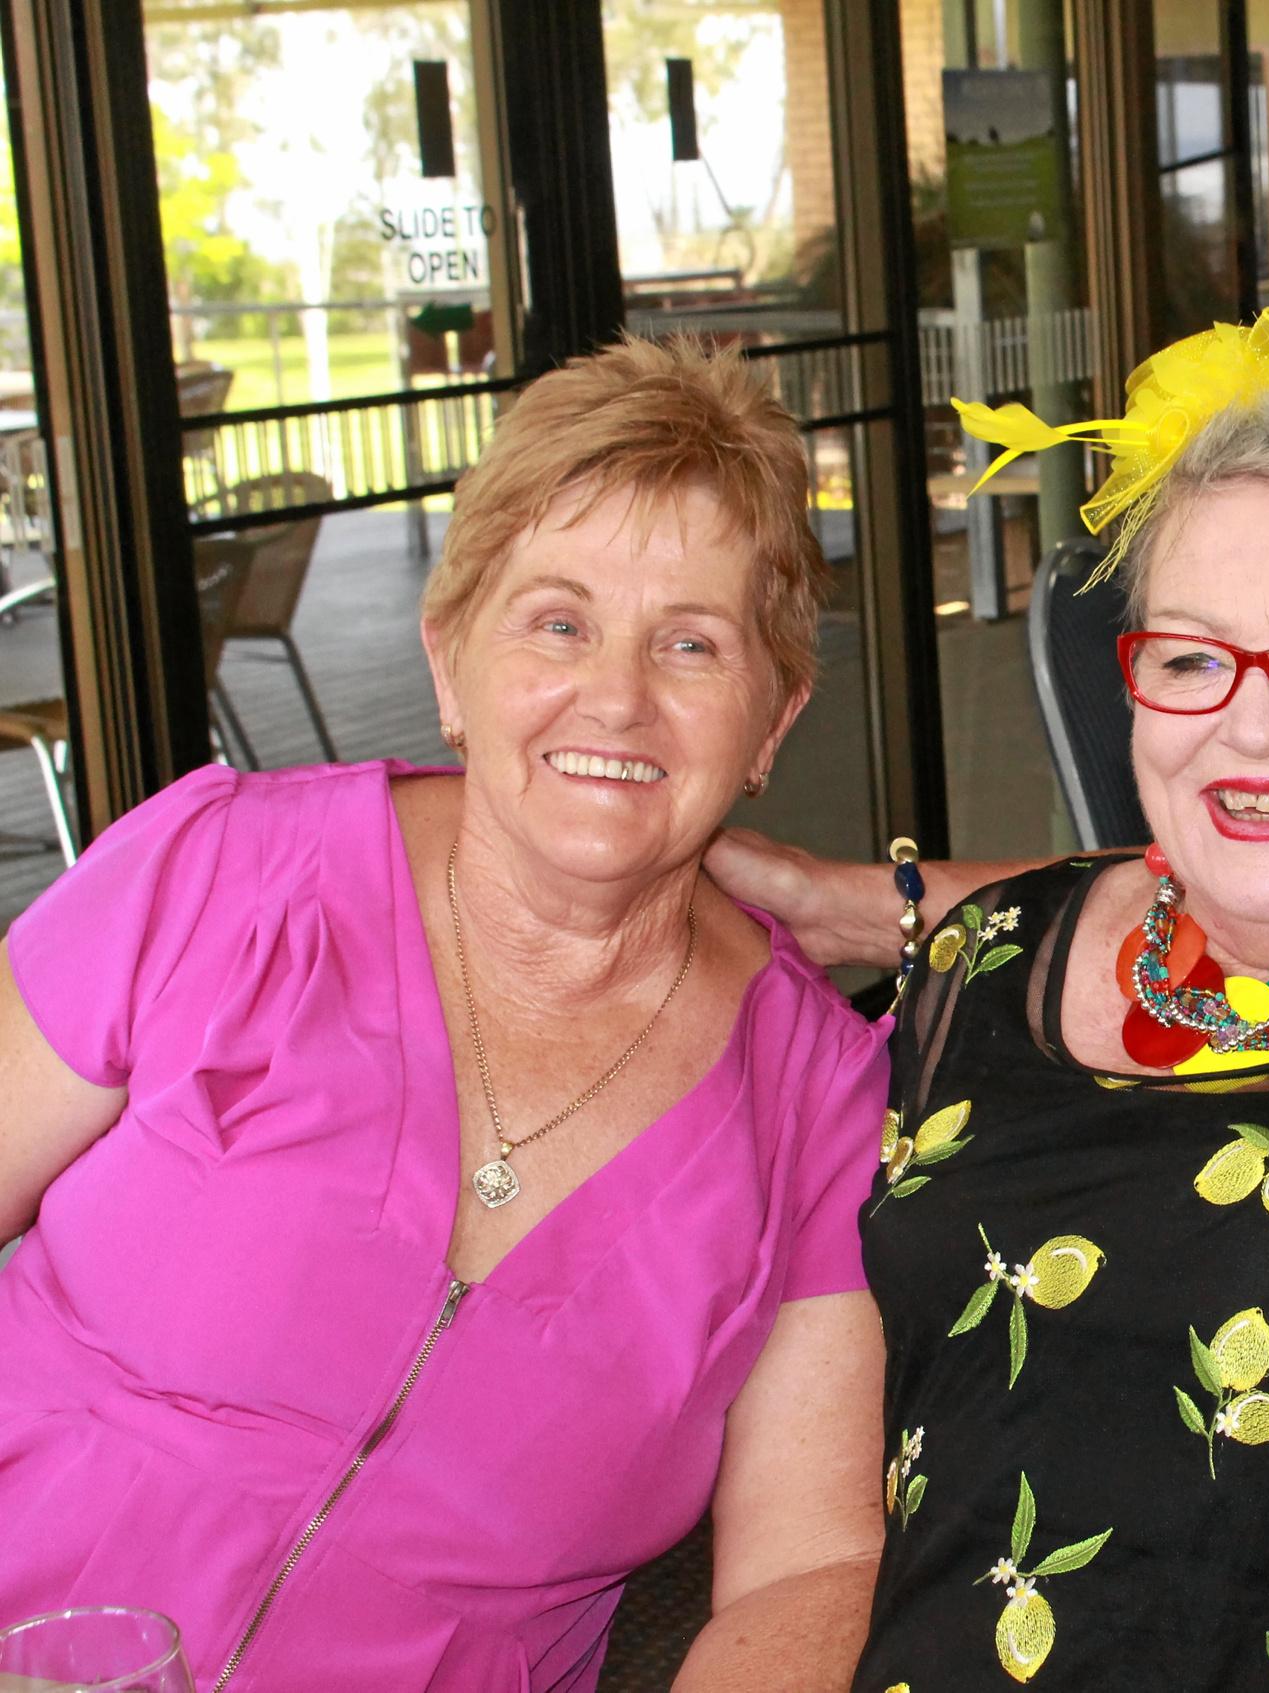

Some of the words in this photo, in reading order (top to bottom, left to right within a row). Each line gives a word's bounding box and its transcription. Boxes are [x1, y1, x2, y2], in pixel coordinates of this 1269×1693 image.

[380, 207, 456, 240] SLIDE
[463, 205, 496, 236] TO
[407, 251, 479, 283] OPEN
